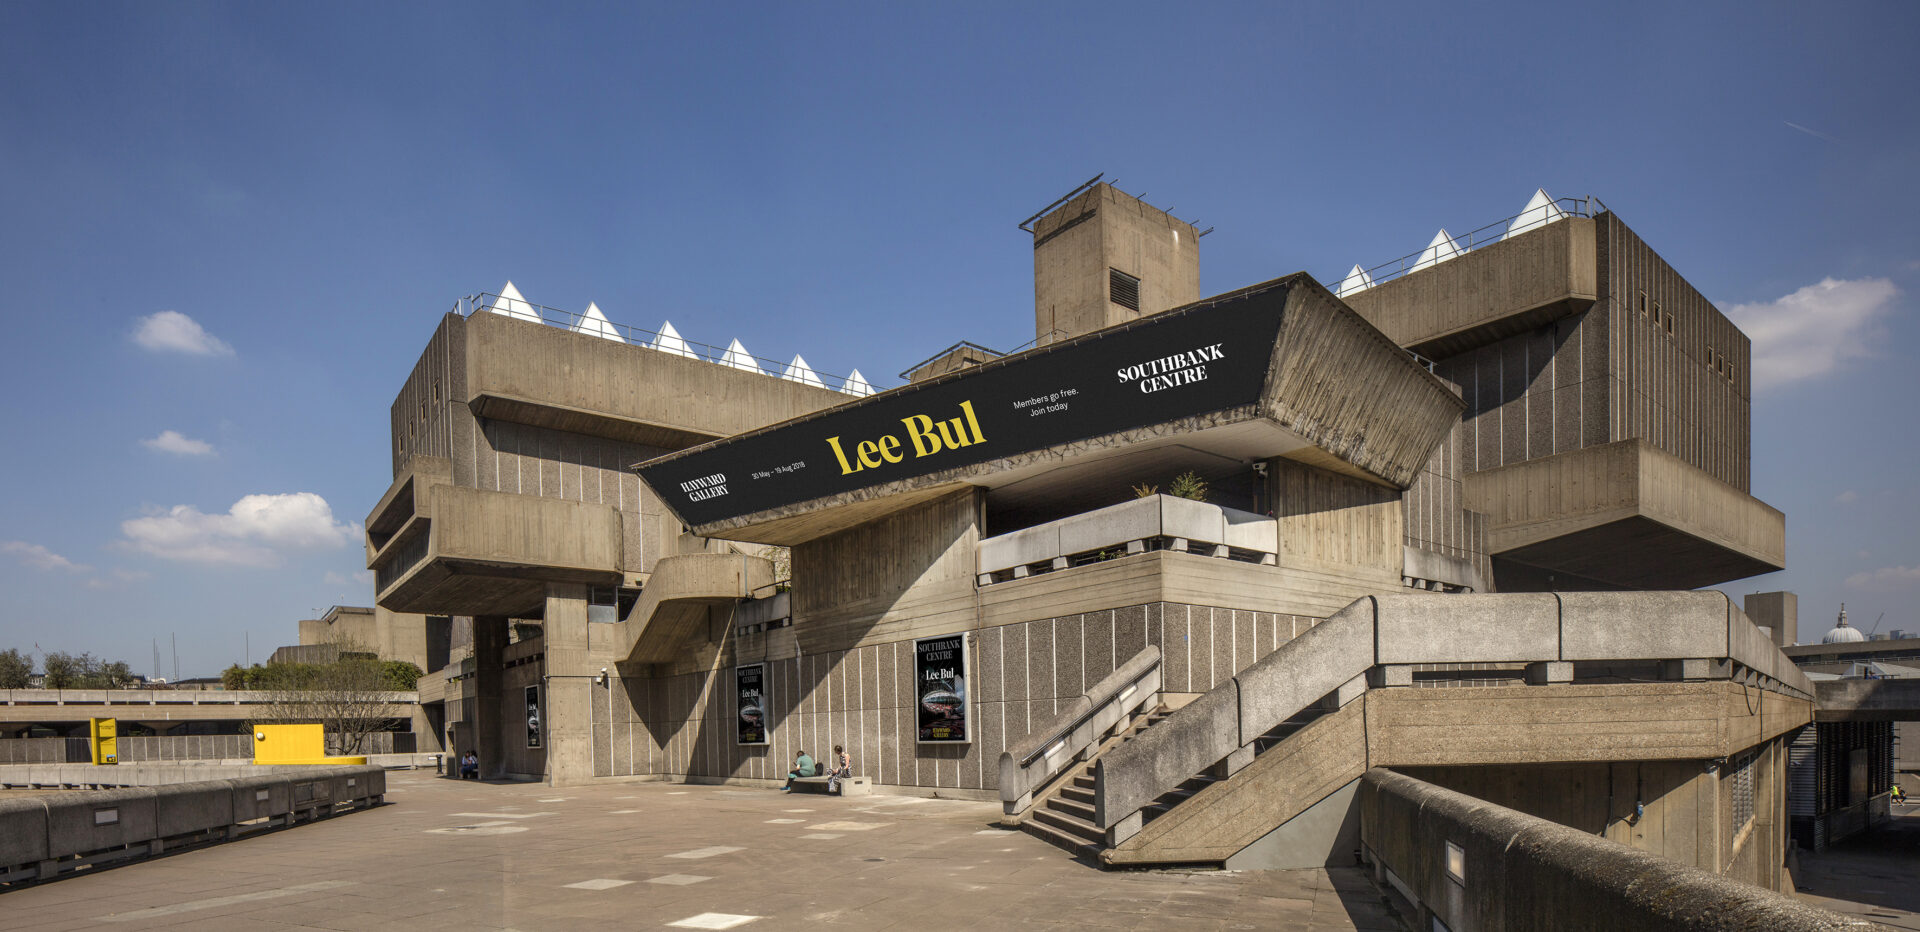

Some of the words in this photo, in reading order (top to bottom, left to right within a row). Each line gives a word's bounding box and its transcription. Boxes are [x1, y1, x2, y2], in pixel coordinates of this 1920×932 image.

[1117, 342, 1225, 384] SOUTHBANK
[1140, 364, 1208, 394] CENTRE
[1013, 395, 1049, 409] Members
[1049, 393, 1060, 402] go
[1060, 388, 1079, 398] free.
[1030, 406, 1046, 417] Join
[1046, 402, 1068, 413] today
[825, 435, 904, 475] Lee
[900, 400, 988, 458] Bul
[751, 472, 760, 480] 30
[759, 470, 771, 479] May
[774, 466, 782, 474] 19
[781, 464, 793, 473] Aug
[792, 461, 805, 470] 2018
[680, 473, 726, 492] HAYWARD
[689, 484, 728, 502] GALLERY
[918, 640, 960, 652] SOUTHBANK
[926, 650, 953, 661] CENTRE
[926, 670, 940, 680] Lee
[940, 667, 954, 678] Bul
[742, 690, 750, 698] Lee
[750, 688, 759, 697] Bul
